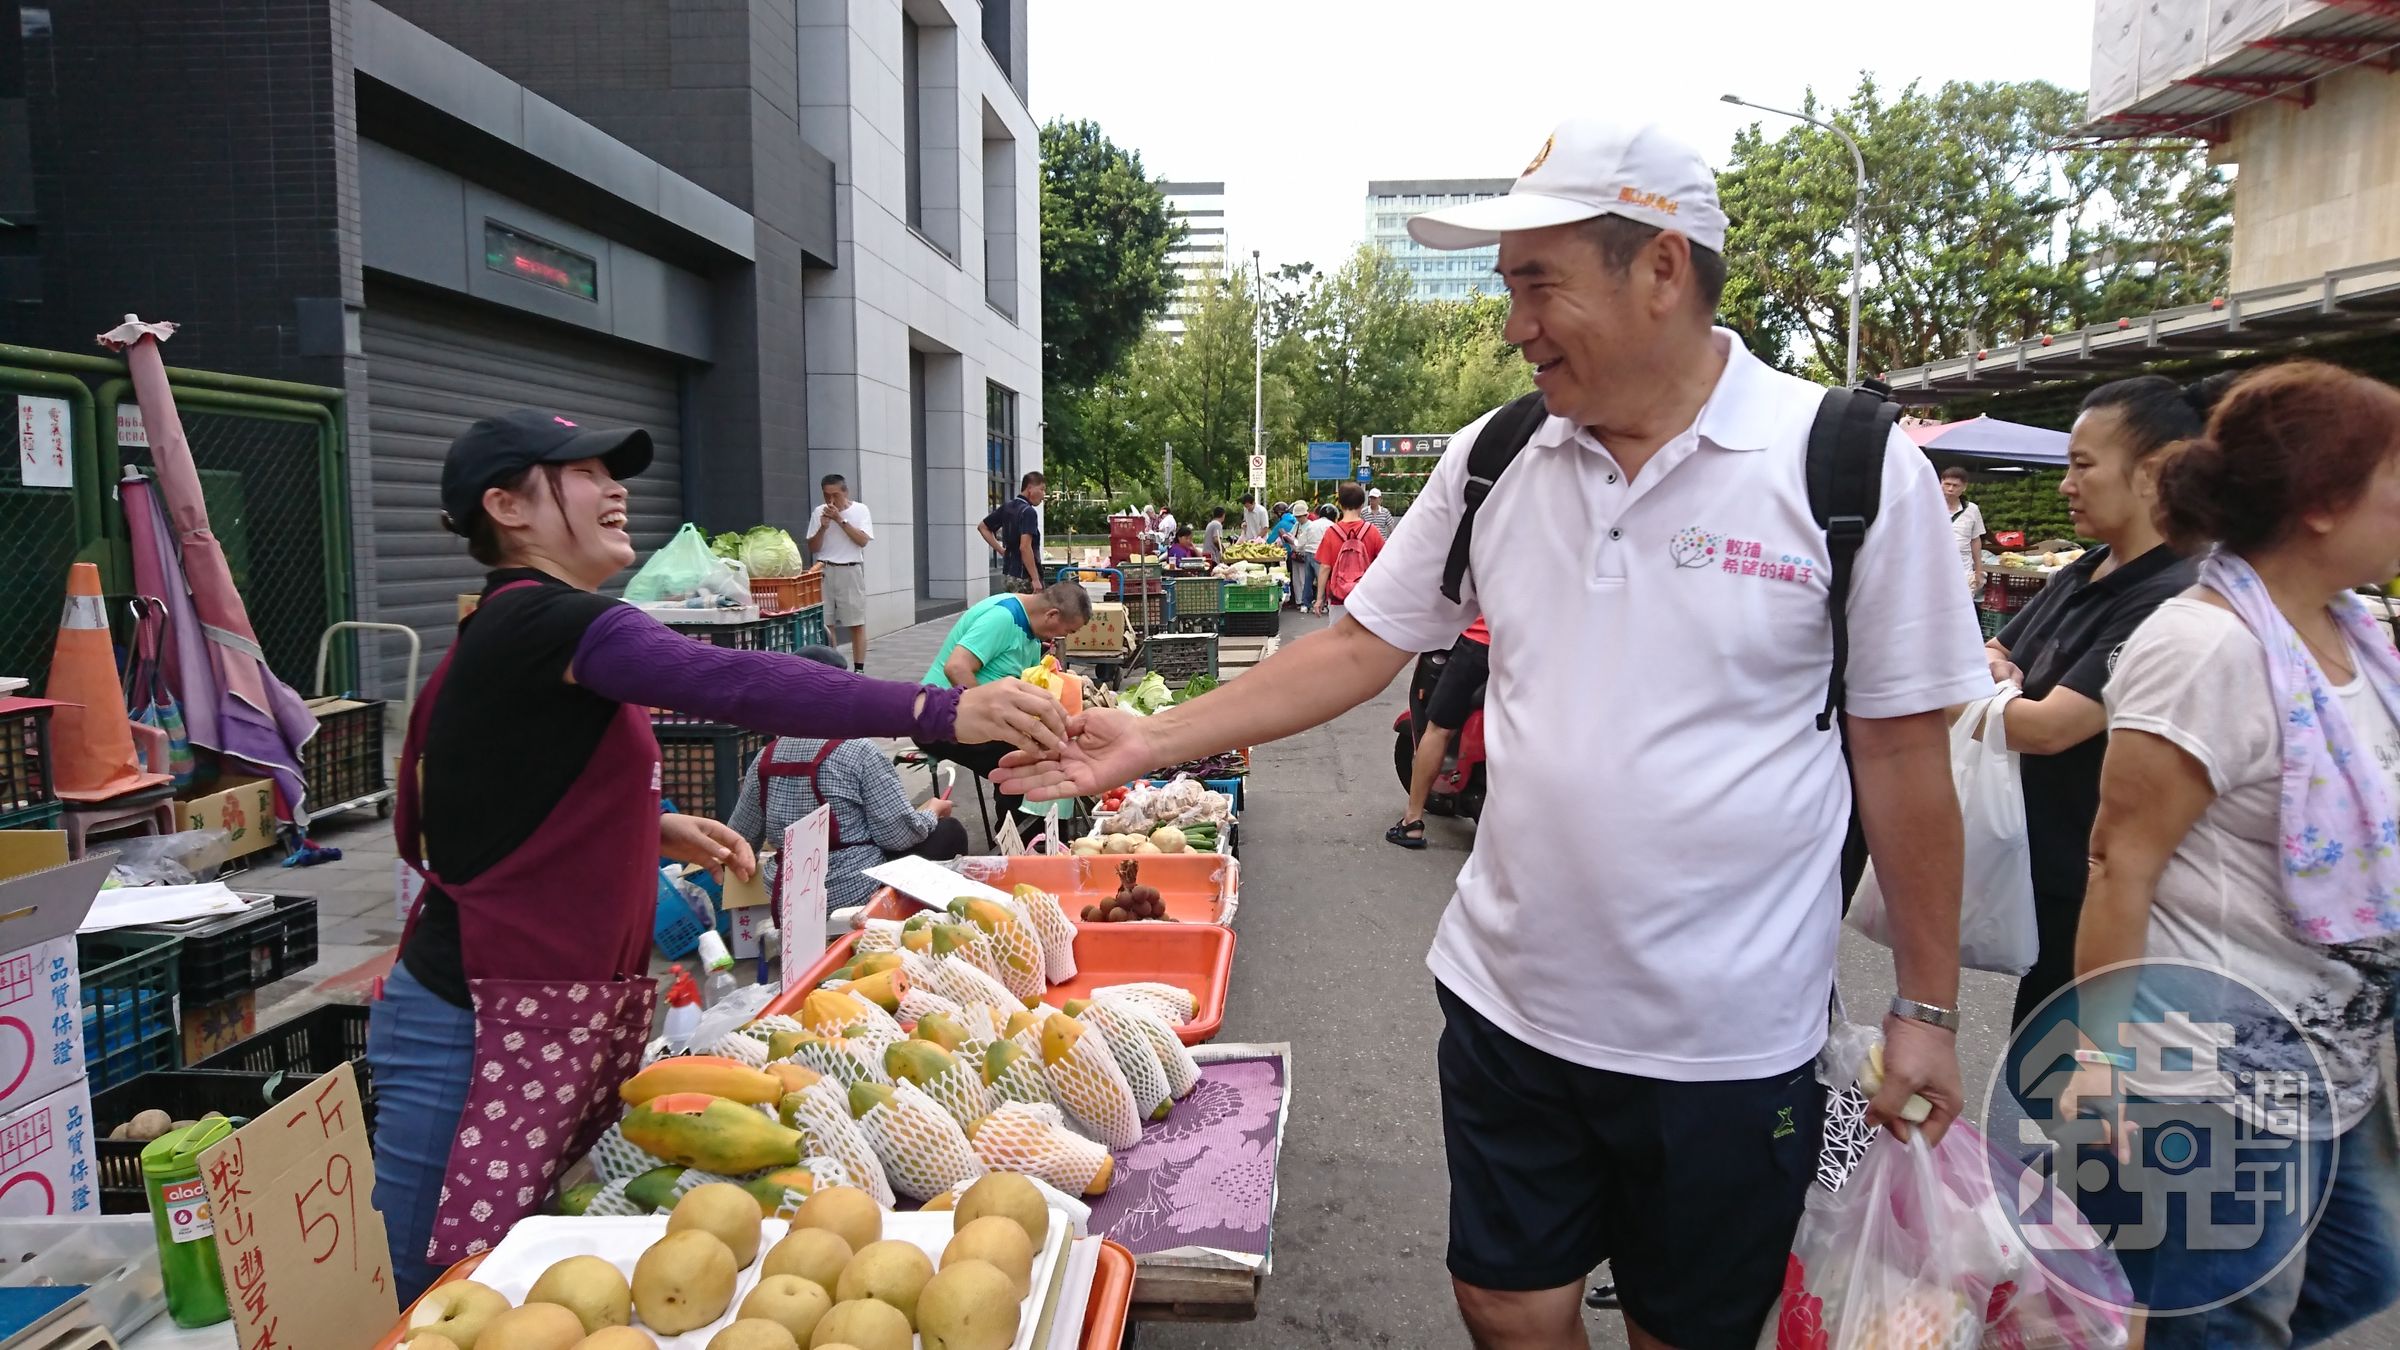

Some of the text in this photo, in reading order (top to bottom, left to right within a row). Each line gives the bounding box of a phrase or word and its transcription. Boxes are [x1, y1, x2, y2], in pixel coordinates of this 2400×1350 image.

[1721, 557, 1813, 584] 希望的種子
[1726, 538, 1762, 559] 散播
[738, 906, 753, 941] 好水
[50, 956, 74, 1065] 品質保證
[66, 1105, 91, 1212] 品質保證
[294, 1153, 358, 1272] 59
